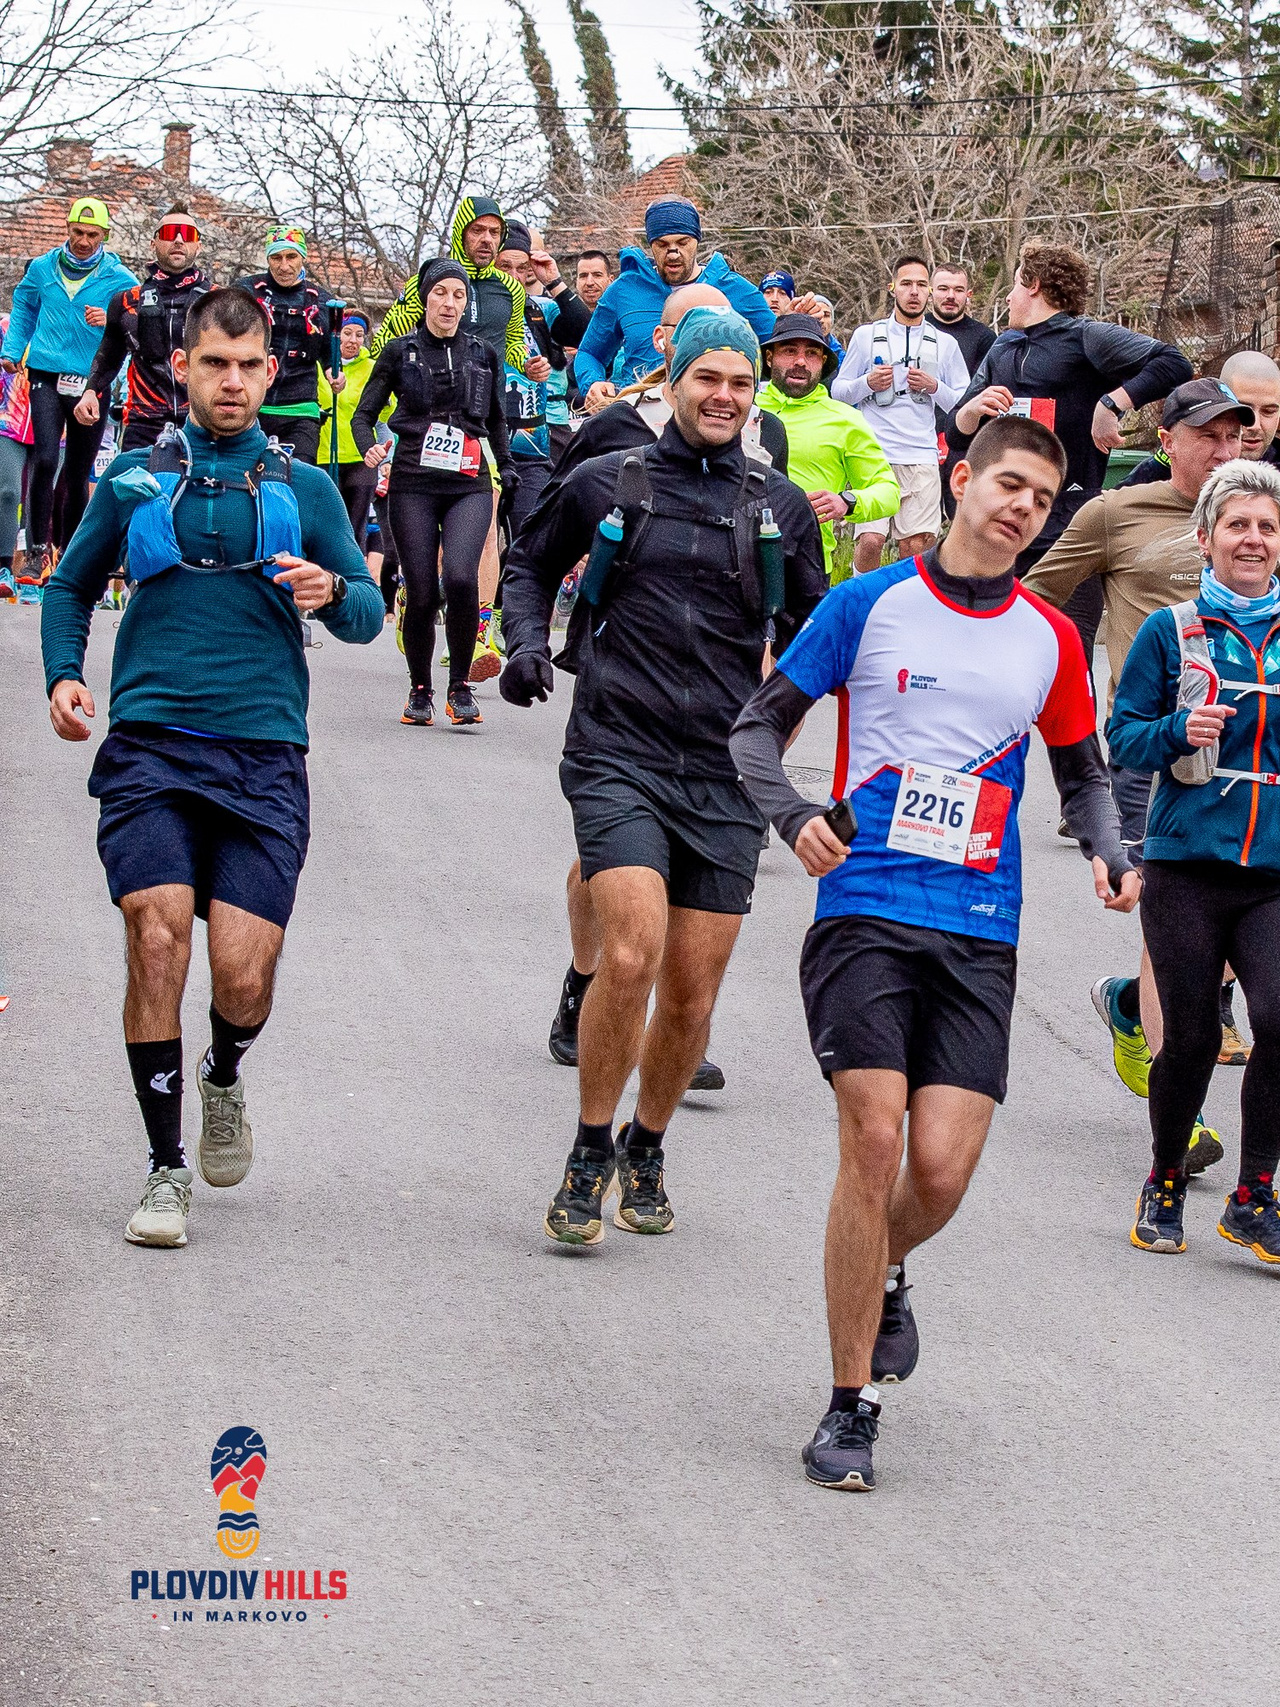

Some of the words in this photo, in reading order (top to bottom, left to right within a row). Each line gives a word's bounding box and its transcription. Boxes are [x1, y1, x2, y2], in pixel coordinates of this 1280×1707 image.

[425, 436, 460, 455] 2222
[1170, 573, 1200, 581] ASICS
[902, 789, 965, 829] 2216
